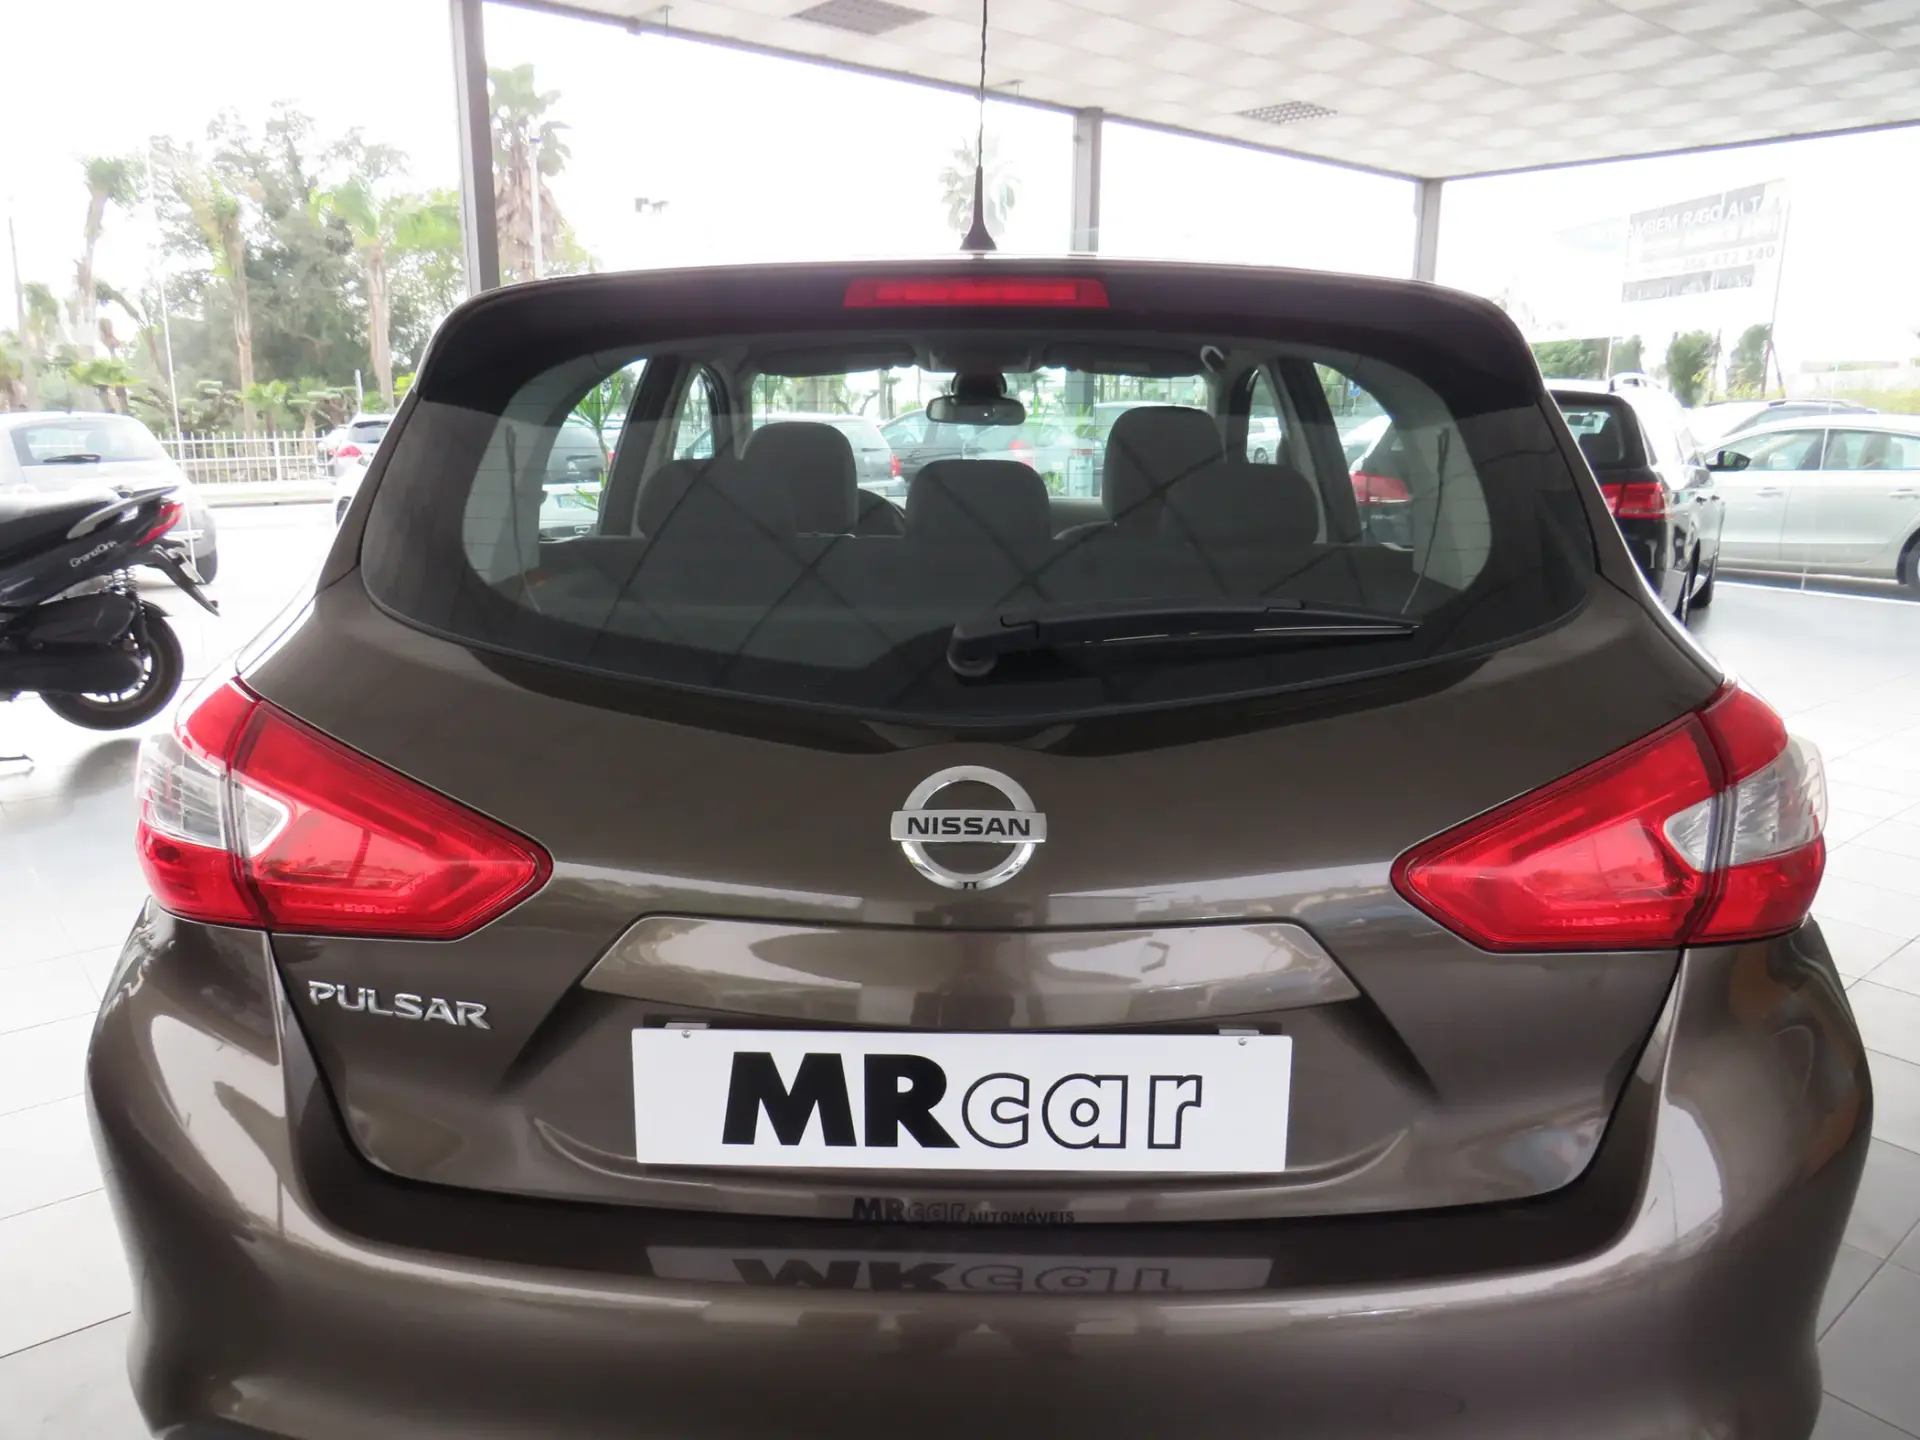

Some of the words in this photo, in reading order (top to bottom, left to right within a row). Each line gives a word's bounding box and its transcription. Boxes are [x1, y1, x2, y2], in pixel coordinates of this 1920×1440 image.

[907, 816, 1031, 837] NISSAN
[308, 980, 491, 1030] PULSAR
[722, 1051, 1203, 1151] MRcar
[852, 1197, 966, 1222] MRcar
[967, 1208, 1076, 1224] AUTOMÓVEIS
